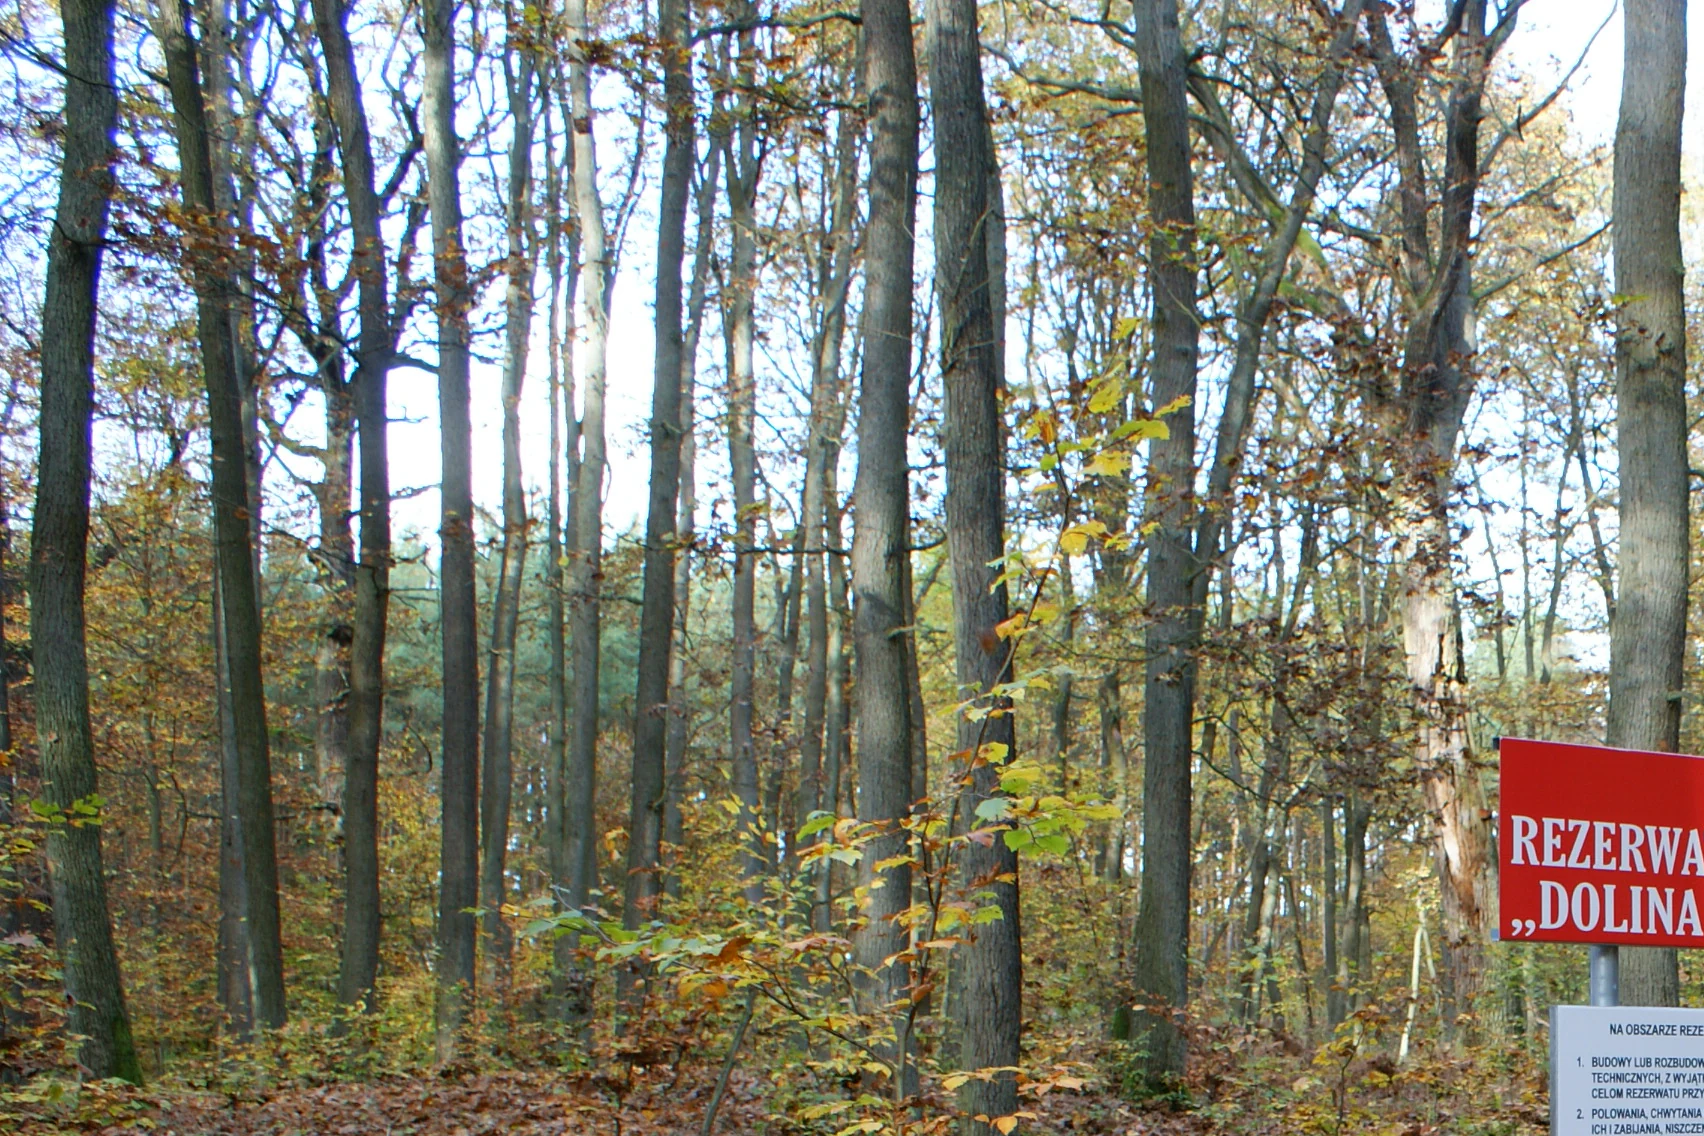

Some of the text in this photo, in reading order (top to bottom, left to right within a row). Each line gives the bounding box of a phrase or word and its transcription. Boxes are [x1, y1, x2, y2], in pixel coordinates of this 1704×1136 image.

[1609, 1023, 1624, 1035] NA
[1625, 1024, 1677, 1036] OBSZARZE
[1591, 1056, 1632, 1067] BUDOWY
[1633, 1057, 1652, 1067] LUB
[1591, 1072, 1663, 1084] TECHNICZNYCH,
[1591, 1087, 1624, 1099] CELOM
[1625, 1087, 1680, 1098] REZERWATU
[1591, 1108, 1648, 1120] POLOWANIA,
[1649, 1107, 1702, 1118] CHWYTANIA
[1591, 1124, 1607, 1135] ICH
[1613, 1123, 1663, 1135] ZABIJANIA,
